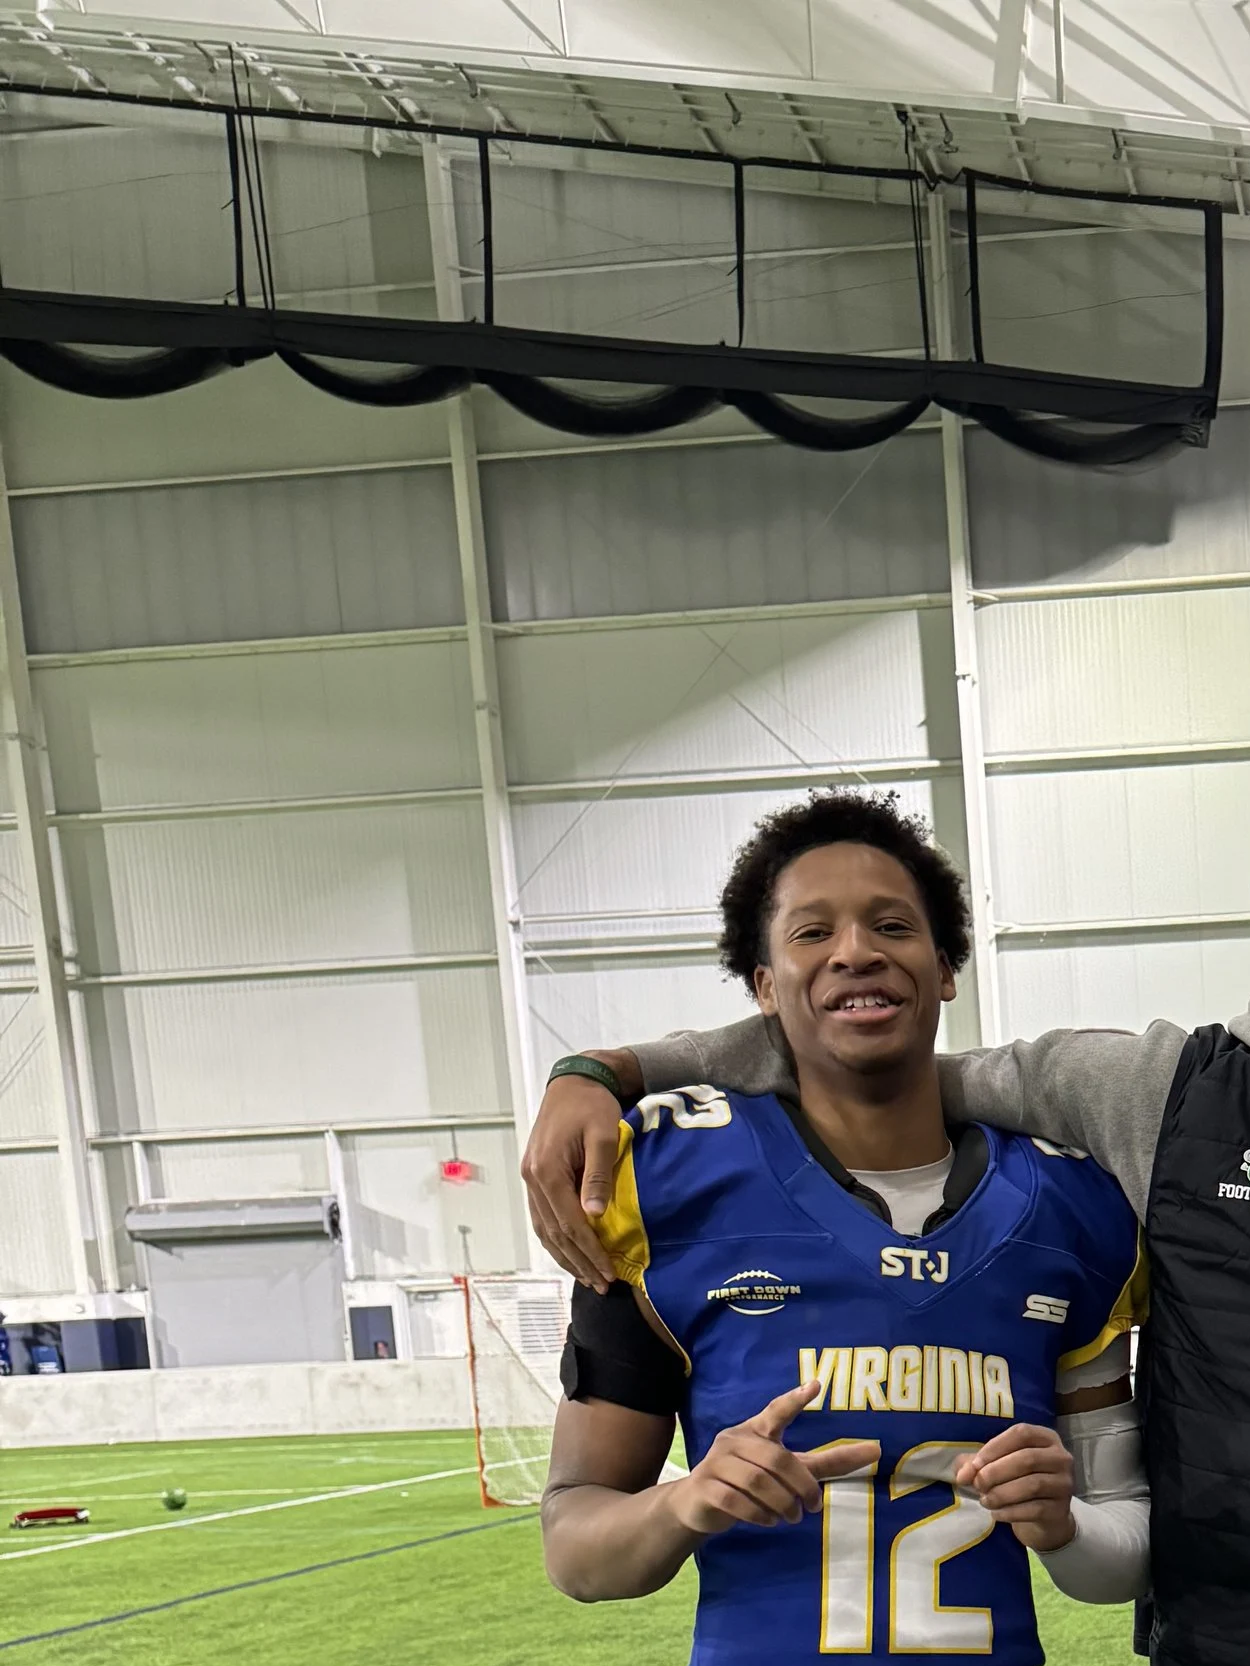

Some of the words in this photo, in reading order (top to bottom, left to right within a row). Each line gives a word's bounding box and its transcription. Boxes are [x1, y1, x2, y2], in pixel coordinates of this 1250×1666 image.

[707, 1287, 750, 1300] FIRST
[753, 1285, 801, 1294] DOWN
[799, 1345, 1014, 1418] VIRGINIA
[806, 1438, 998, 1655] 12
